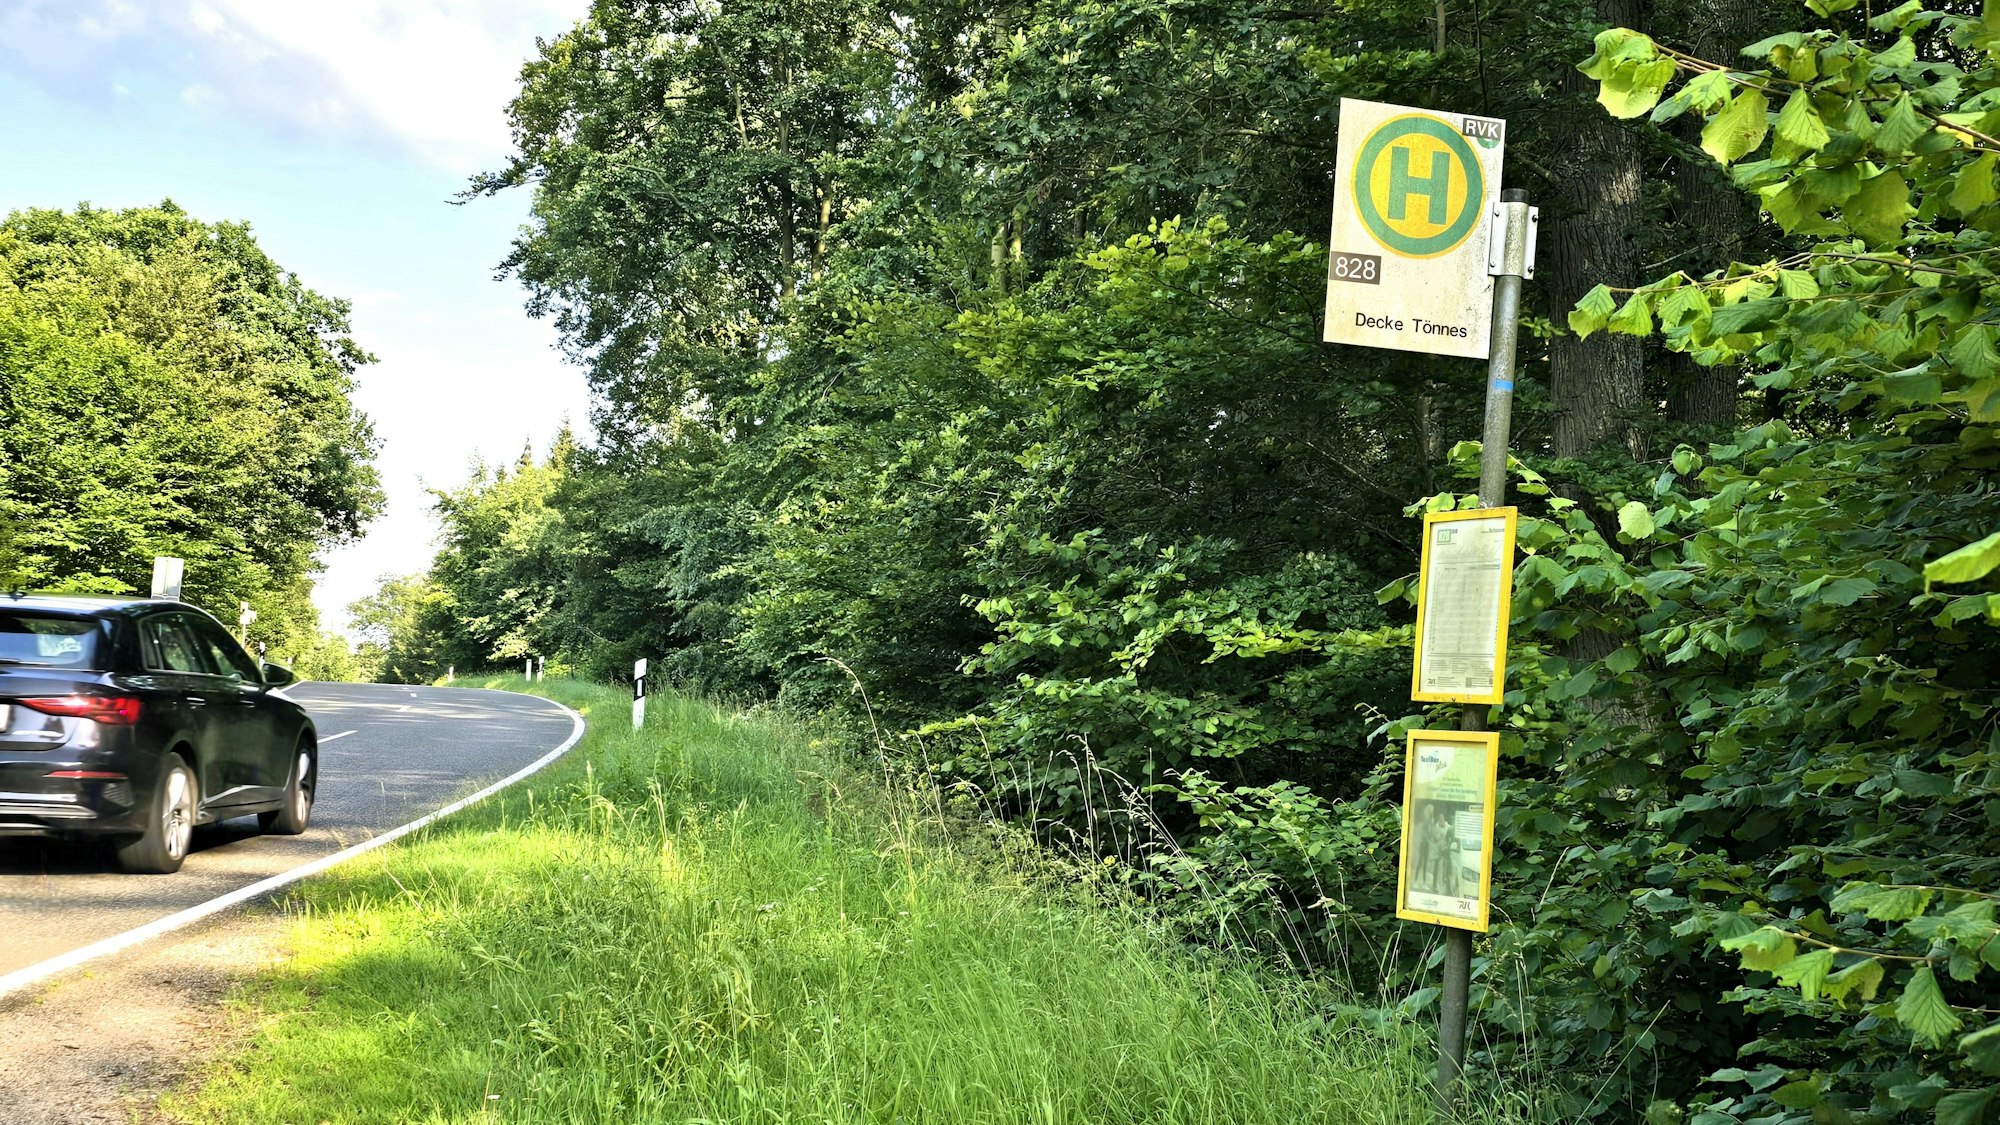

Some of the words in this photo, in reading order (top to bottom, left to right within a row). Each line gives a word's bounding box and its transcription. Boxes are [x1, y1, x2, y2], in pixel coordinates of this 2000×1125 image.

[1465, 119, 1499, 139] RVK
[1388, 146, 1450, 225] H
[1335, 256, 1376, 280] 828
[1355, 312, 1404, 331] Decke
[1412, 318, 1468, 338] Tönnes
